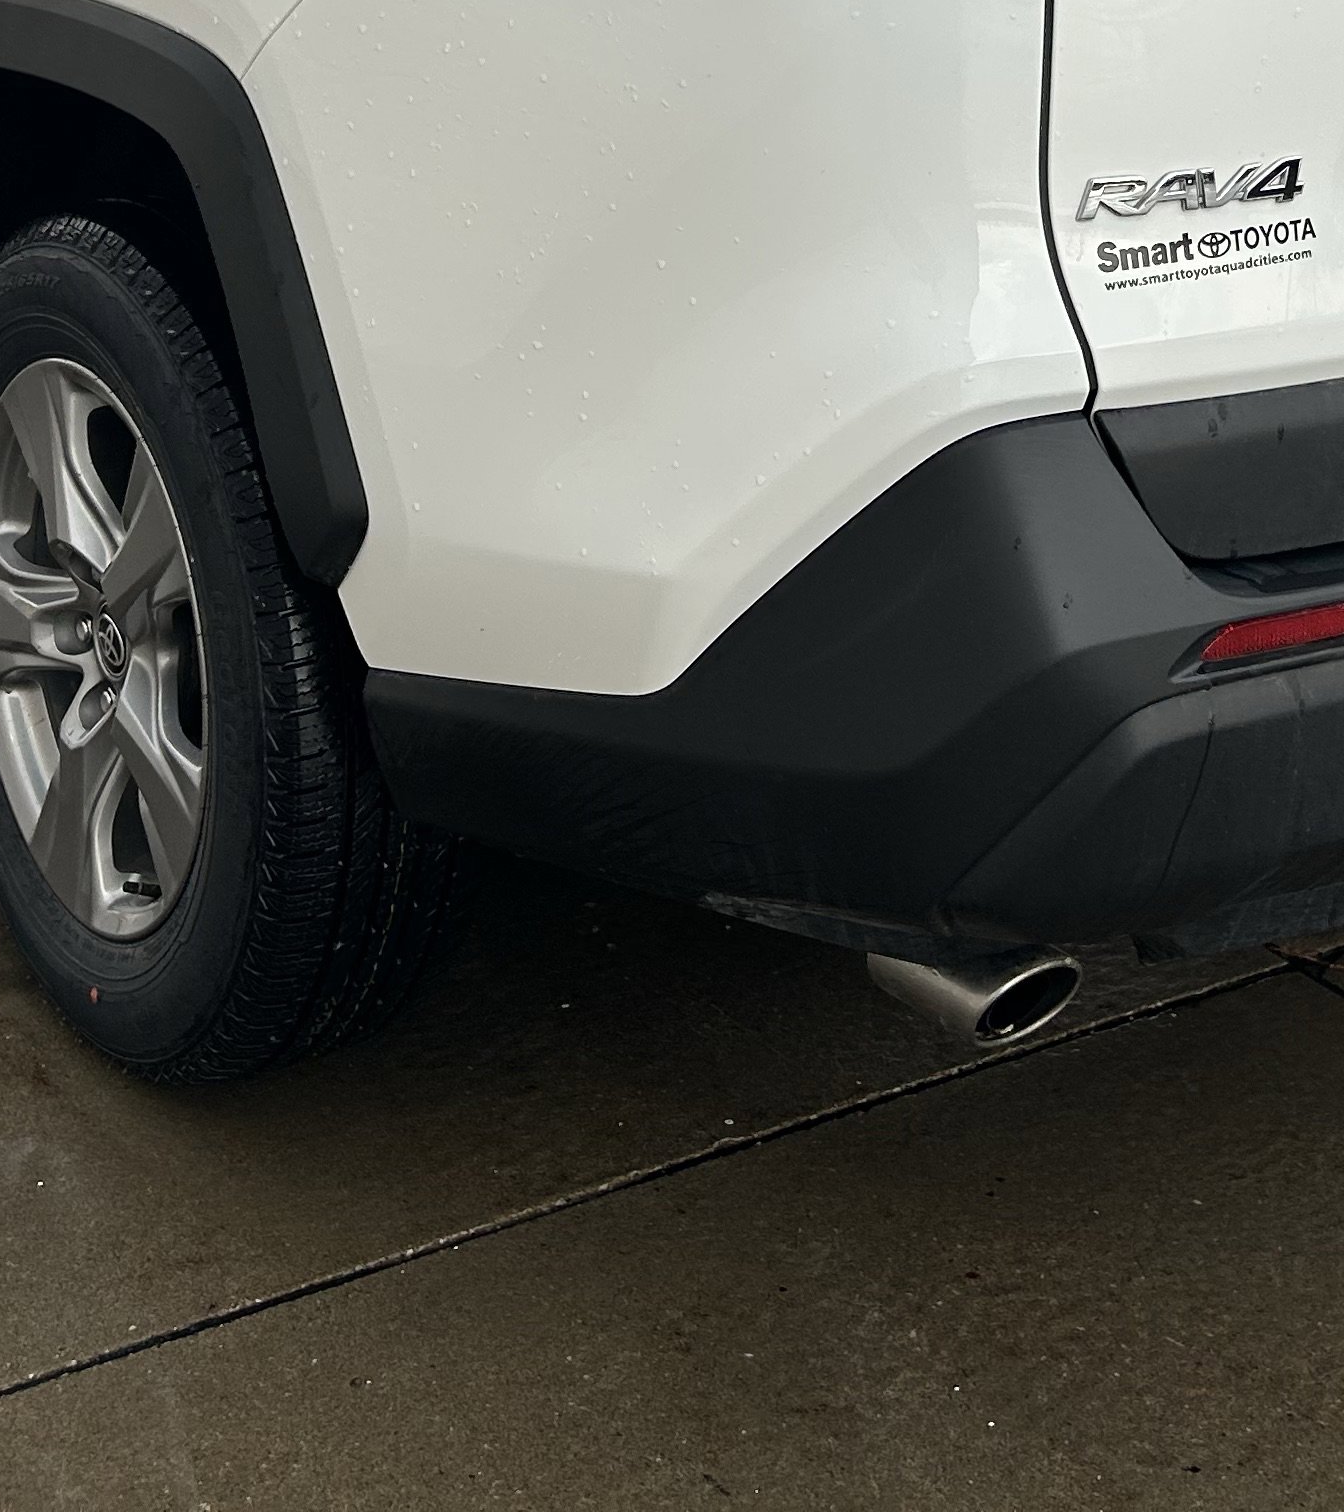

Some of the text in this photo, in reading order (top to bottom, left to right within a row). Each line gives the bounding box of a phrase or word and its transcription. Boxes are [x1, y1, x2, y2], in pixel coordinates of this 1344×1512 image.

[1075, 155, 1305, 221] RAV4
[1097, 217, 1316, 273] Smart TOYOTA
[1104, 248, 1312, 291] www.smarttoyotaquadcities.com
